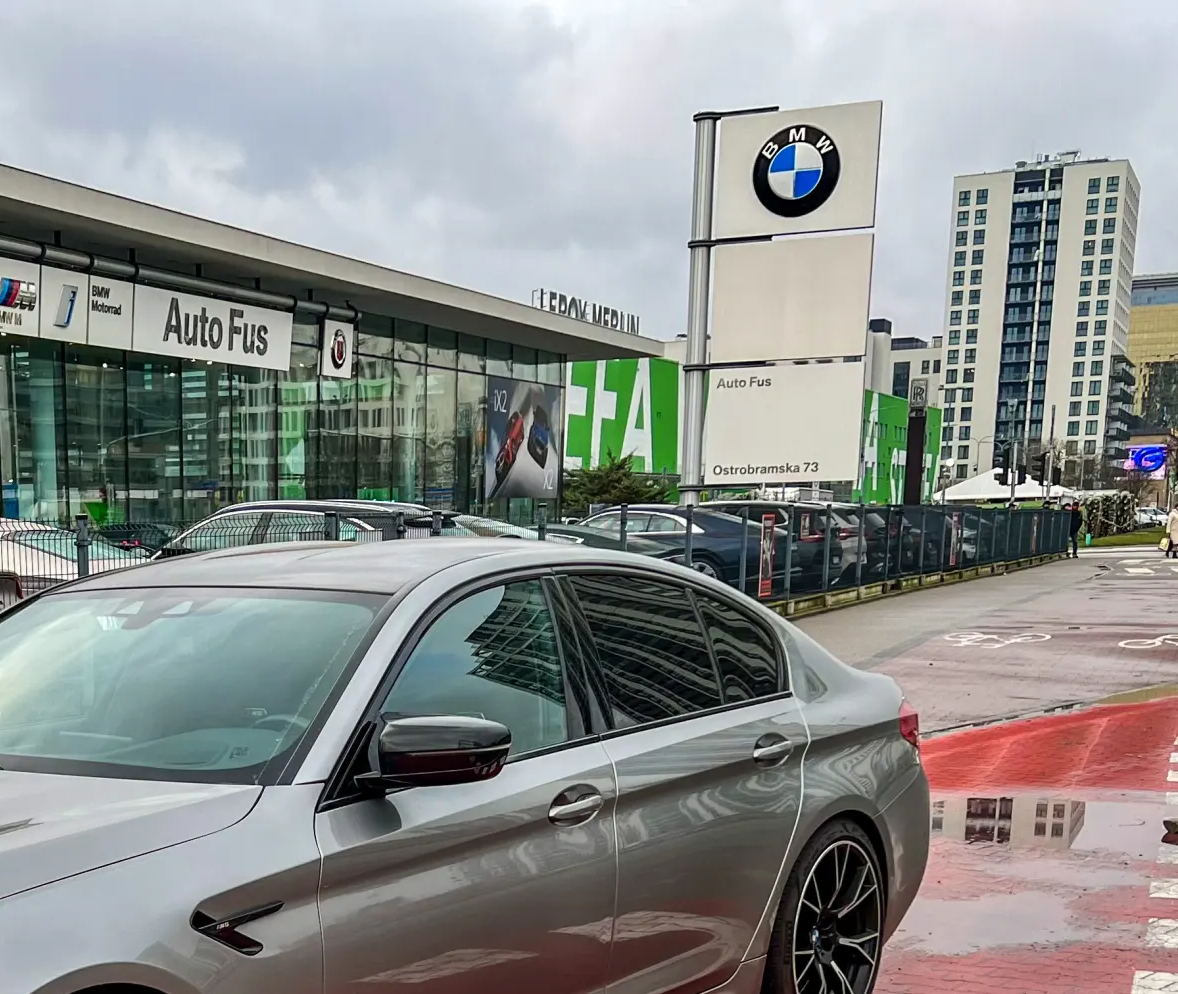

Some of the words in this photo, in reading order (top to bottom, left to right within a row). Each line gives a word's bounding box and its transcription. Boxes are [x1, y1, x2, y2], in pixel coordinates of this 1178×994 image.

[762, 127, 833, 160] BMW
[91, 285, 111, 299] BMW
[91, 300, 122, 316] Motorrad
[162, 297, 223, 350] Auto
[227, 309, 269, 356] Fus
[716, 378, 747, 389] Auto
[749, 376, 772, 387] Fus
[493, 389, 507, 413] iX2
[713, 463, 800, 476] Ostrobramska
[803, 462, 819, 473] 73
